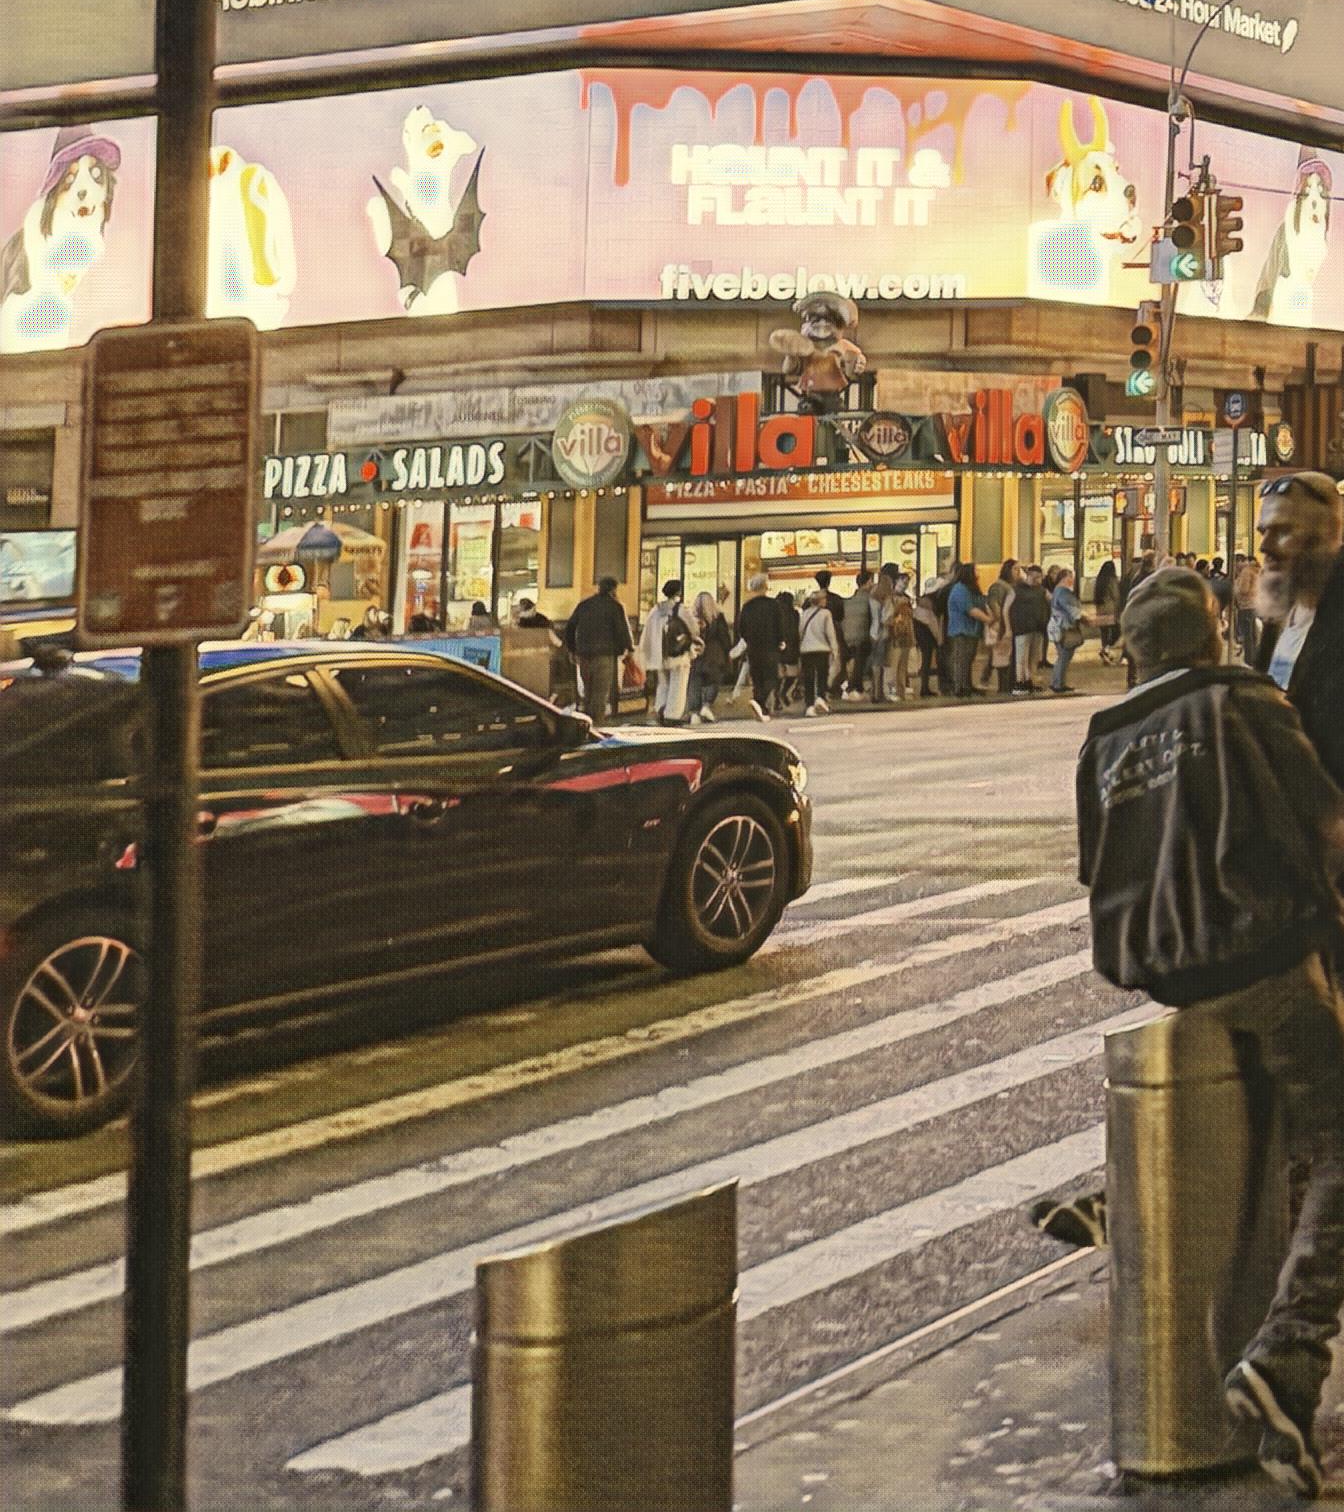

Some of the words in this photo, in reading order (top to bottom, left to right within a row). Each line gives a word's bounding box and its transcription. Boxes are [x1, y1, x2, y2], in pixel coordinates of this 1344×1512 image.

[1223, 3, 1282, 46] Market
[856, 147, 901, 186] IT
[907, 147, 952, 188] &
[893, 187, 937, 226] IT
[659, 262, 966, 300] fivebelow.com
[555, 421, 622, 458] villa
[637, 391, 816, 478] villa
[933, 388, 1046, 466] villa
[263, 453, 348, 498] PIZZA
[390, 440, 506, 492] SALADS
[734, 478, 789, 497] PASTA
[806, 469, 936, 494] CHEESESTEAKS
